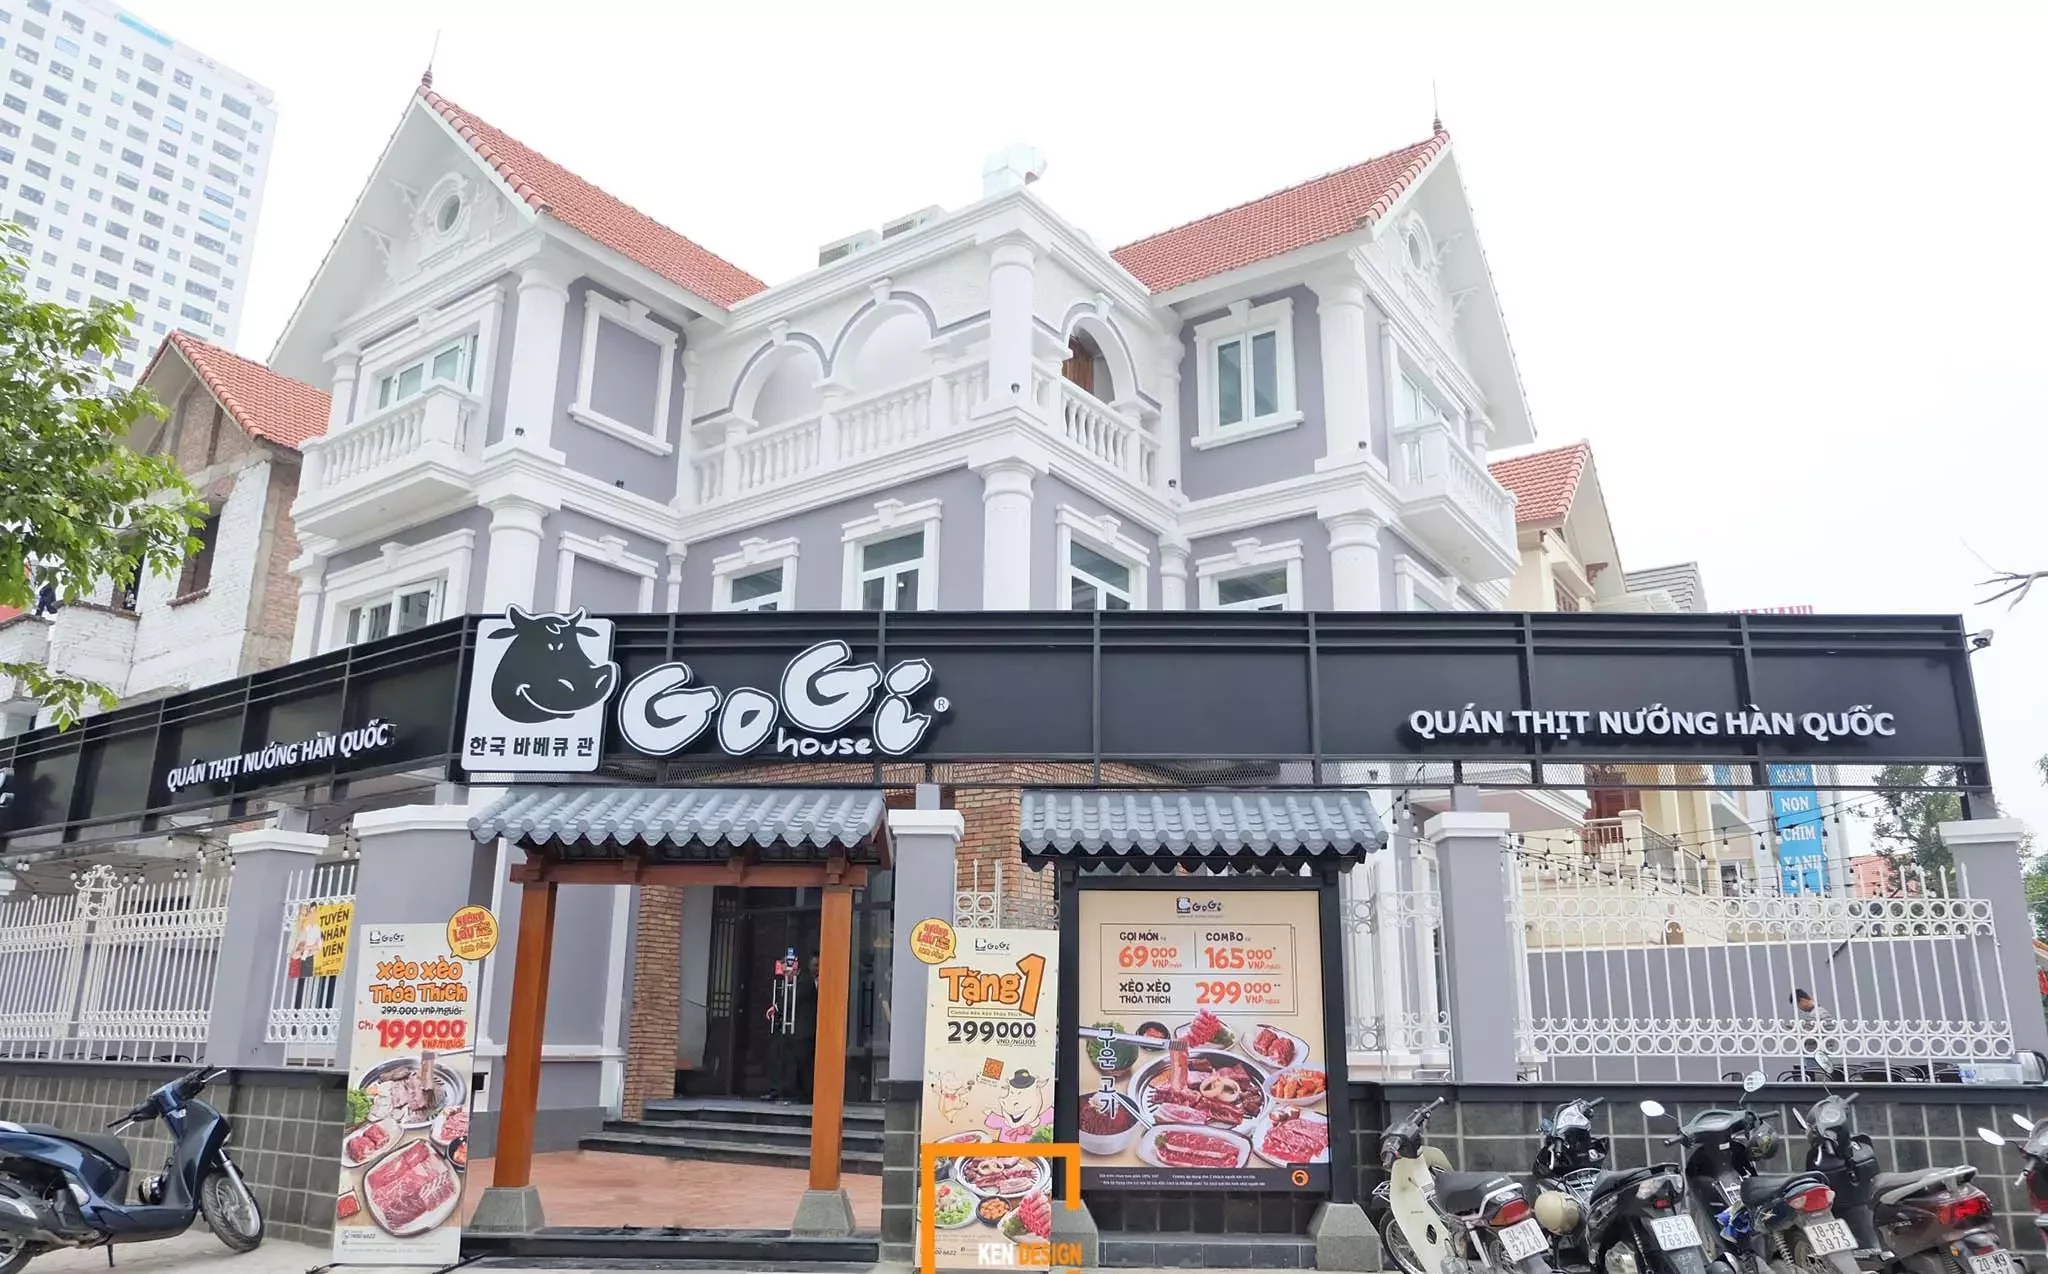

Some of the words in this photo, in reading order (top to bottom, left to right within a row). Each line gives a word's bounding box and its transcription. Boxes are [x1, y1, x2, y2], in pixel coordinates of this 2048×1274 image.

[617, 639, 934, 756] GoGi
[1409, 703, 1503, 739] QUÁN
[1512, 709, 1589, 740] THỊT
[1600, 702, 1718, 736] NƯỚNG
[1726, 704, 1794, 736] HÀN
[1803, 704, 1896, 741] QUỐC
[469, 736, 506, 757] 한국
[513, 735, 571, 757] 바베큐
[577, 735, 595, 757] 관
[776, 727, 873, 758] house
[167, 758, 205, 792] QUÁN
[208, 754, 242, 782] THỊT
[243, 741, 298, 773] NƯỚNG
[301, 731, 336, 761] HÀN
[340, 719, 390, 758] QUỐC
[1780, 796, 1809, 813] NON
[1782, 826, 1816, 842] CHIM
[321, 924, 347, 942] NHÂN
[1119, 932, 1137, 944] GỌI
[1139, 929, 1159, 942] MÓN
[1206, 932, 1243, 942] COMBO
[323, 941, 344, 958] VIÊN
[939, 966, 1022, 1007] Tặng
[1016, 953, 1046, 1017] 1
[1119, 979, 1144, 993] XÈO
[1147, 979, 1171, 993] XÈO
[1119, 992, 1144, 1005] THỎA
[1146, 993, 1171, 1005] THÍCH
[1098, 1028, 1117, 1069] 구운
[1098, 1077, 1117, 1119] 고기
